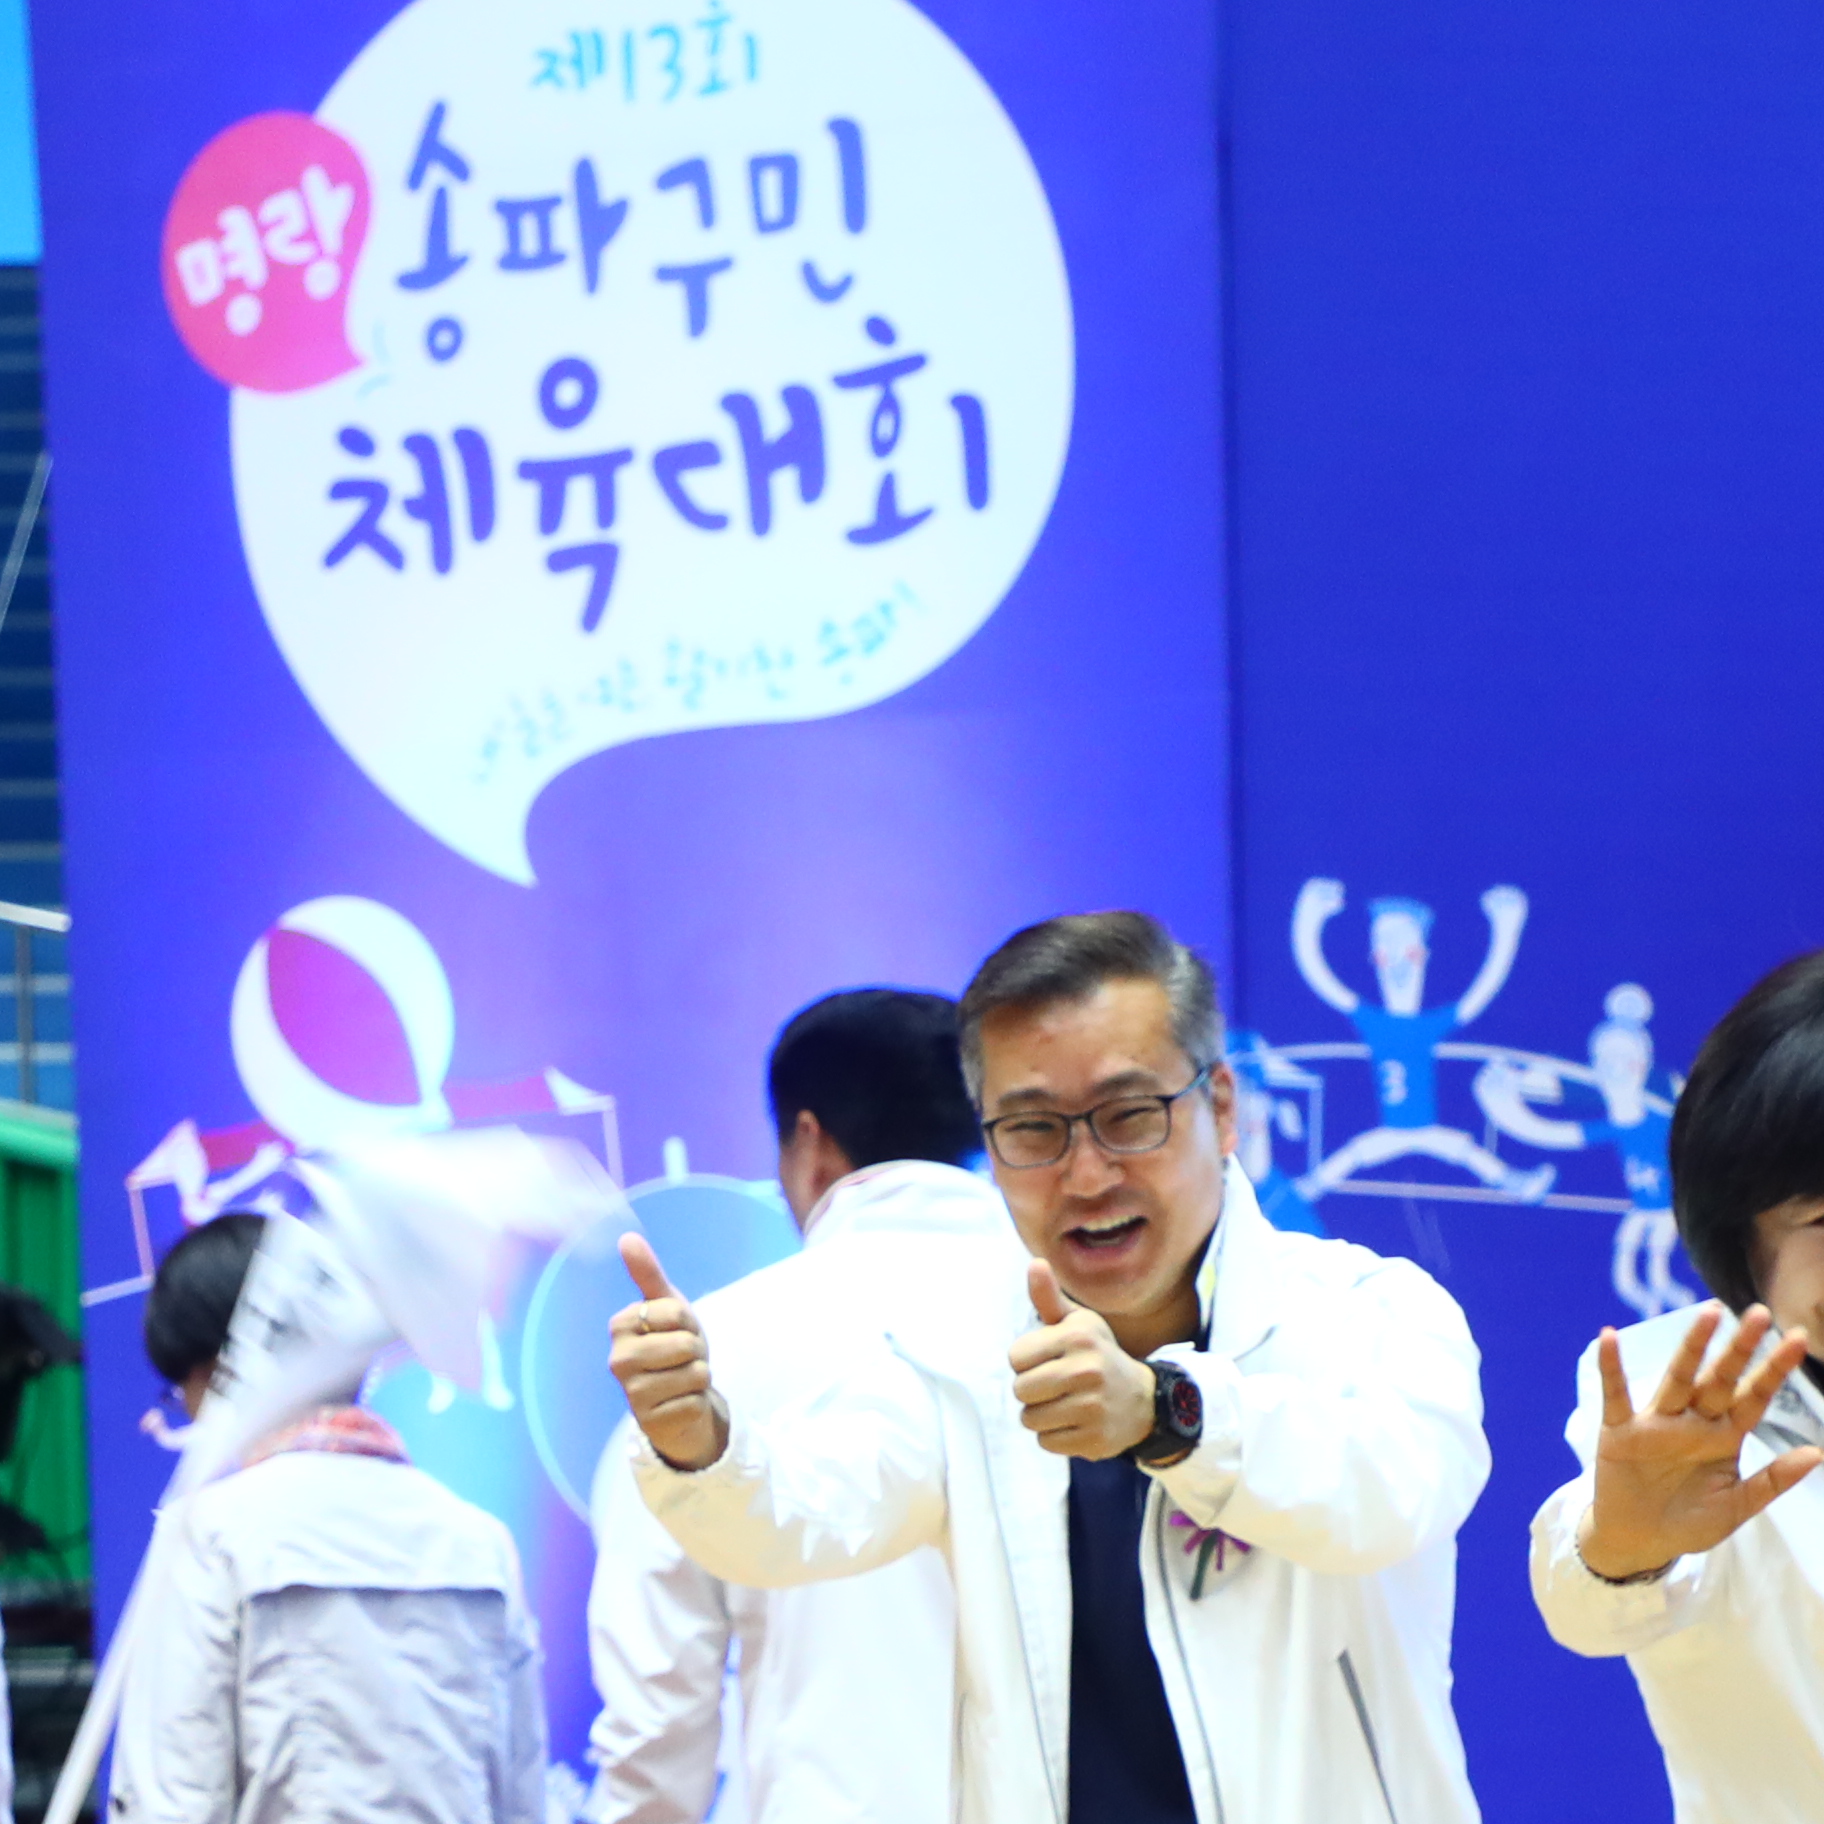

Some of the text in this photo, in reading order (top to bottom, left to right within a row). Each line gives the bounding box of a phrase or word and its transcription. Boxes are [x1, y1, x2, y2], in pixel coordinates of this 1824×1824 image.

[528, 0, 764, 104] 제13회
[173, 98, 870, 365] 명랑 송파구민
[321, 314, 994, 636] 체육대회
